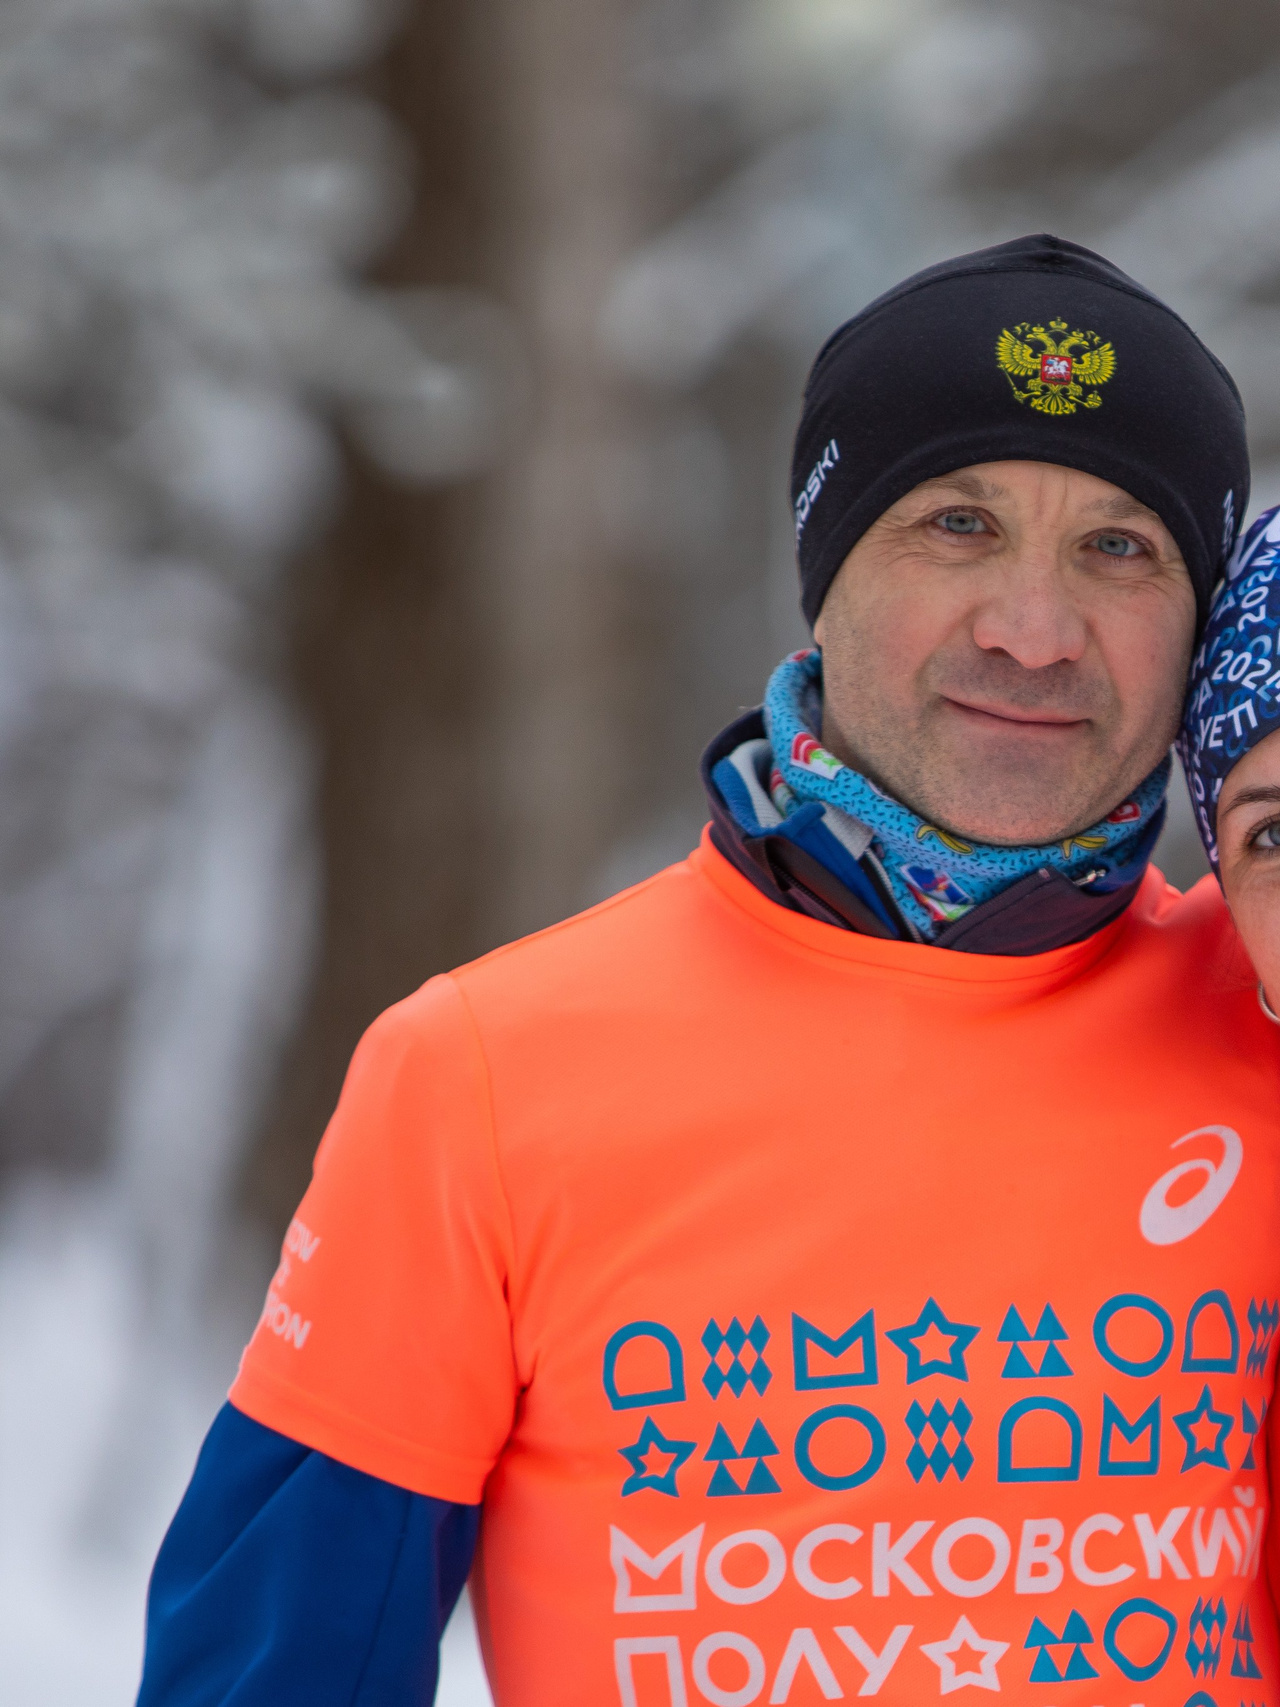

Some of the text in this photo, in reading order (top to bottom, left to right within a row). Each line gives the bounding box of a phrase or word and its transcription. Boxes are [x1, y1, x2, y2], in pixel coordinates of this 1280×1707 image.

[1199, 698, 1259, 751] YETI
[609, 1485, 1264, 1614] МОСКОВСКИЙ
[613, 1624, 915, 1707] ПОЛУ
